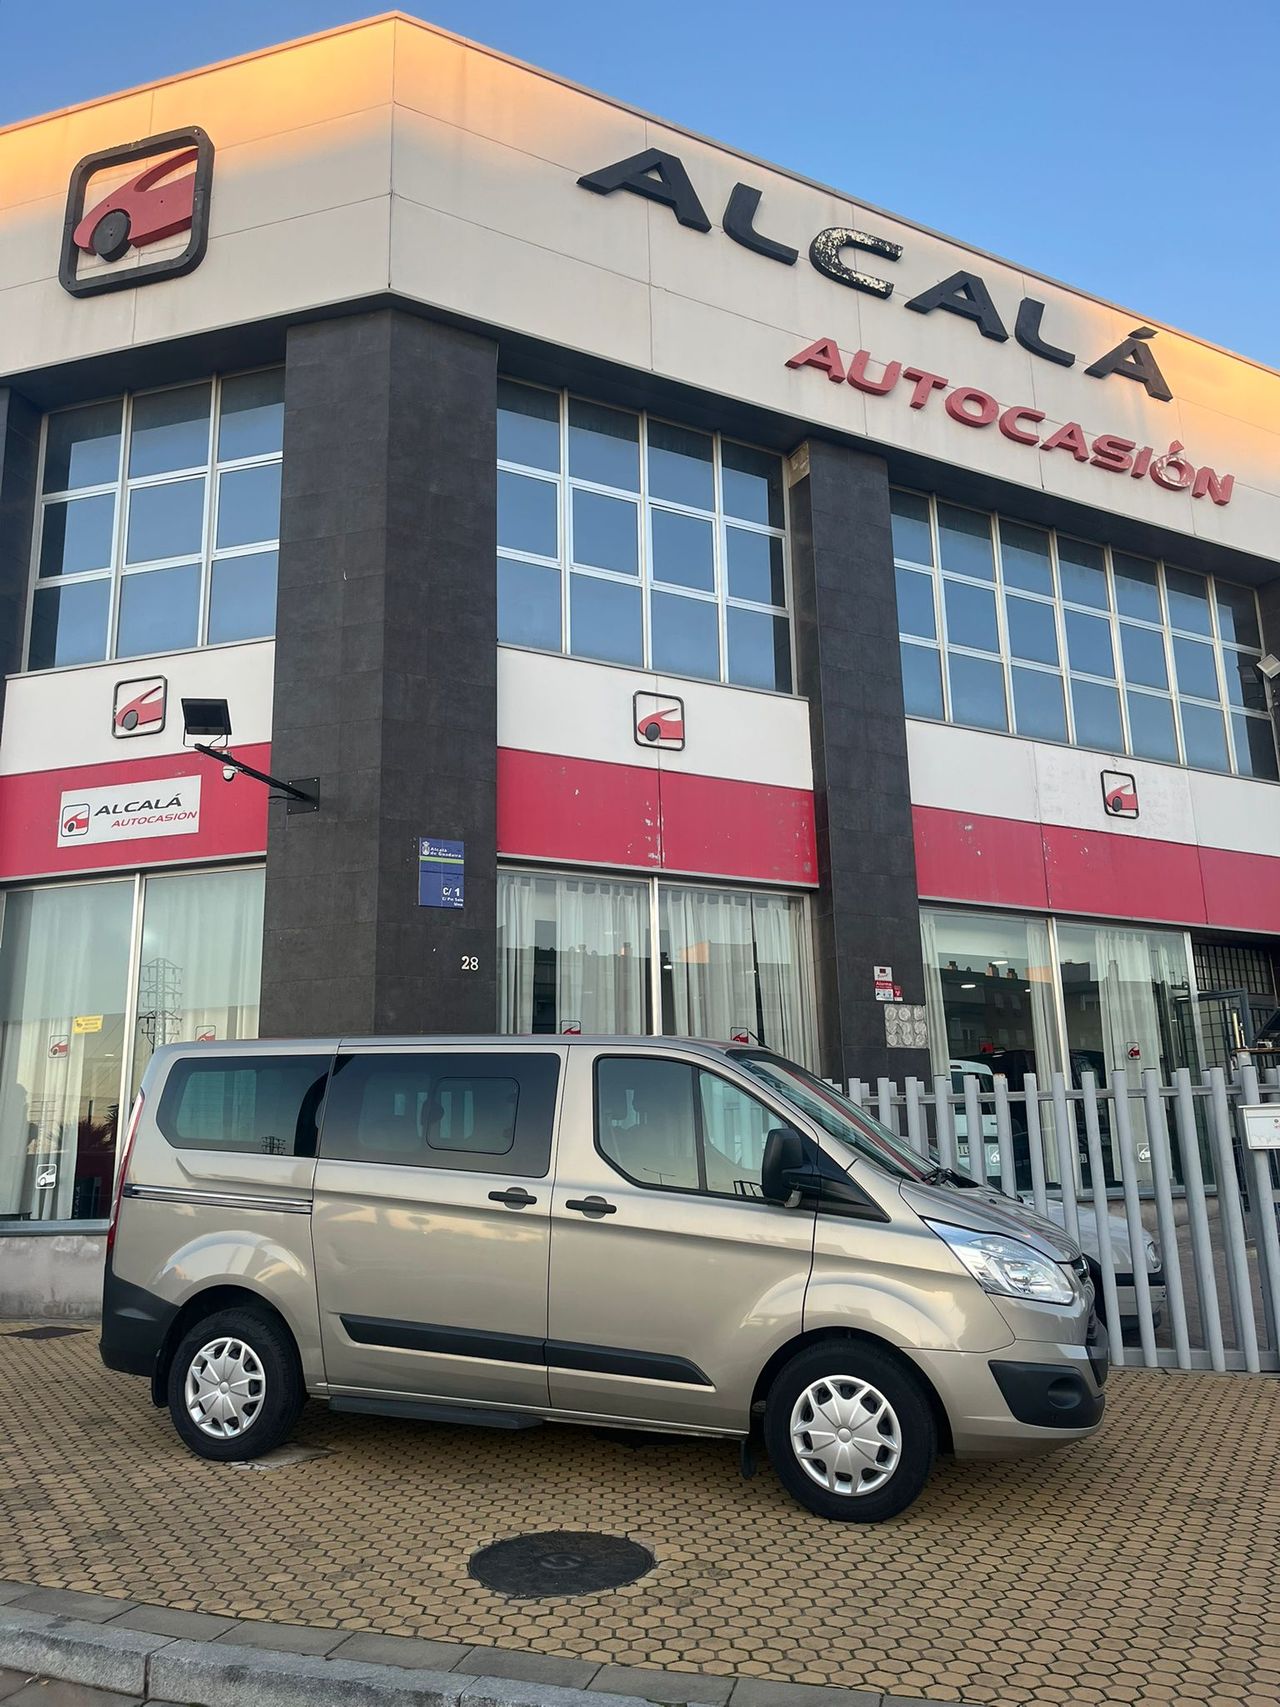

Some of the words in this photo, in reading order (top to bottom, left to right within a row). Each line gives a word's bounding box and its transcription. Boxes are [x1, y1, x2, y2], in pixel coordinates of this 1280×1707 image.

[577, 147, 1173, 401] ALCALÁ
[785, 337, 1235, 506] AUTOCASIÓN
[95, 793, 182, 816] ALCALÁ
[111, 811, 197, 828] AUTOCASIÓN
[454, 887, 460, 897] 1
[461, 955, 479, 971] 28
